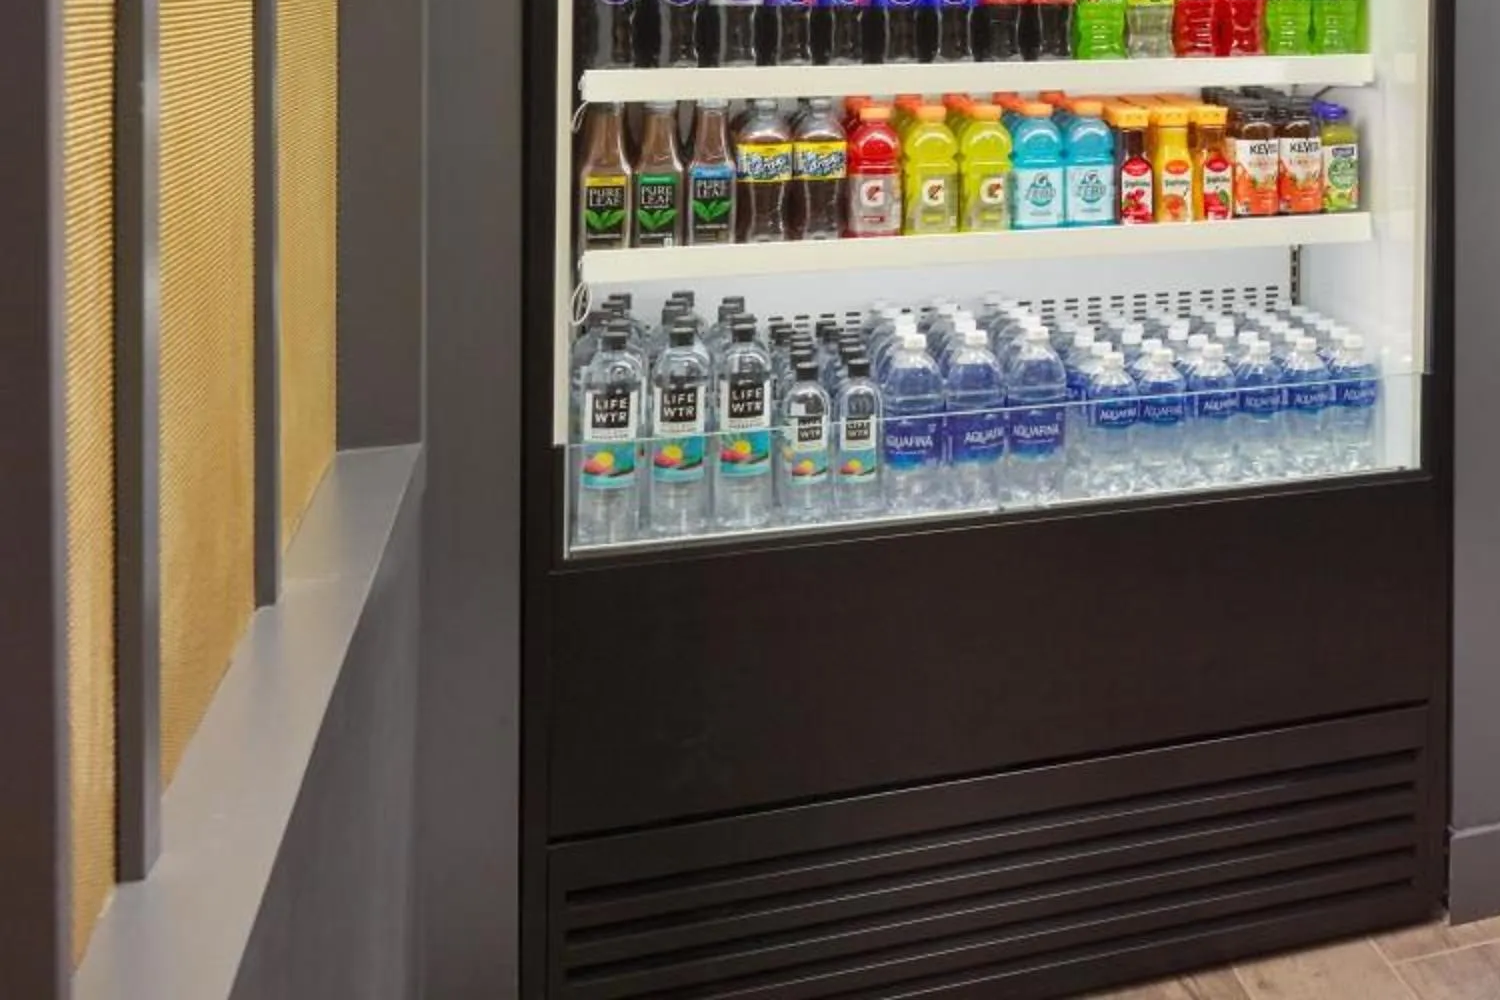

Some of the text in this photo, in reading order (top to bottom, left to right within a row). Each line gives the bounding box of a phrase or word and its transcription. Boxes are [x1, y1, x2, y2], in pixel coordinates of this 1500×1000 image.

[696, 180, 728, 190] PURE
[589, 187, 623, 198] PURE
[641, 186, 673, 197] PURE
[697, 189, 727, 199] LEAF
[589, 199, 623, 208] LEAF
[641, 196, 672, 206] LEAF
[663, 394, 695, 406] LIFE
[731, 388, 763, 400] LIFE
[594, 399, 629, 411] LIFE
[731, 401, 763, 413] WTR
[594, 411, 626, 424] WTR
[663, 406, 697, 418] WTR
[1012, 423, 1059, 437] AQUAFINA
